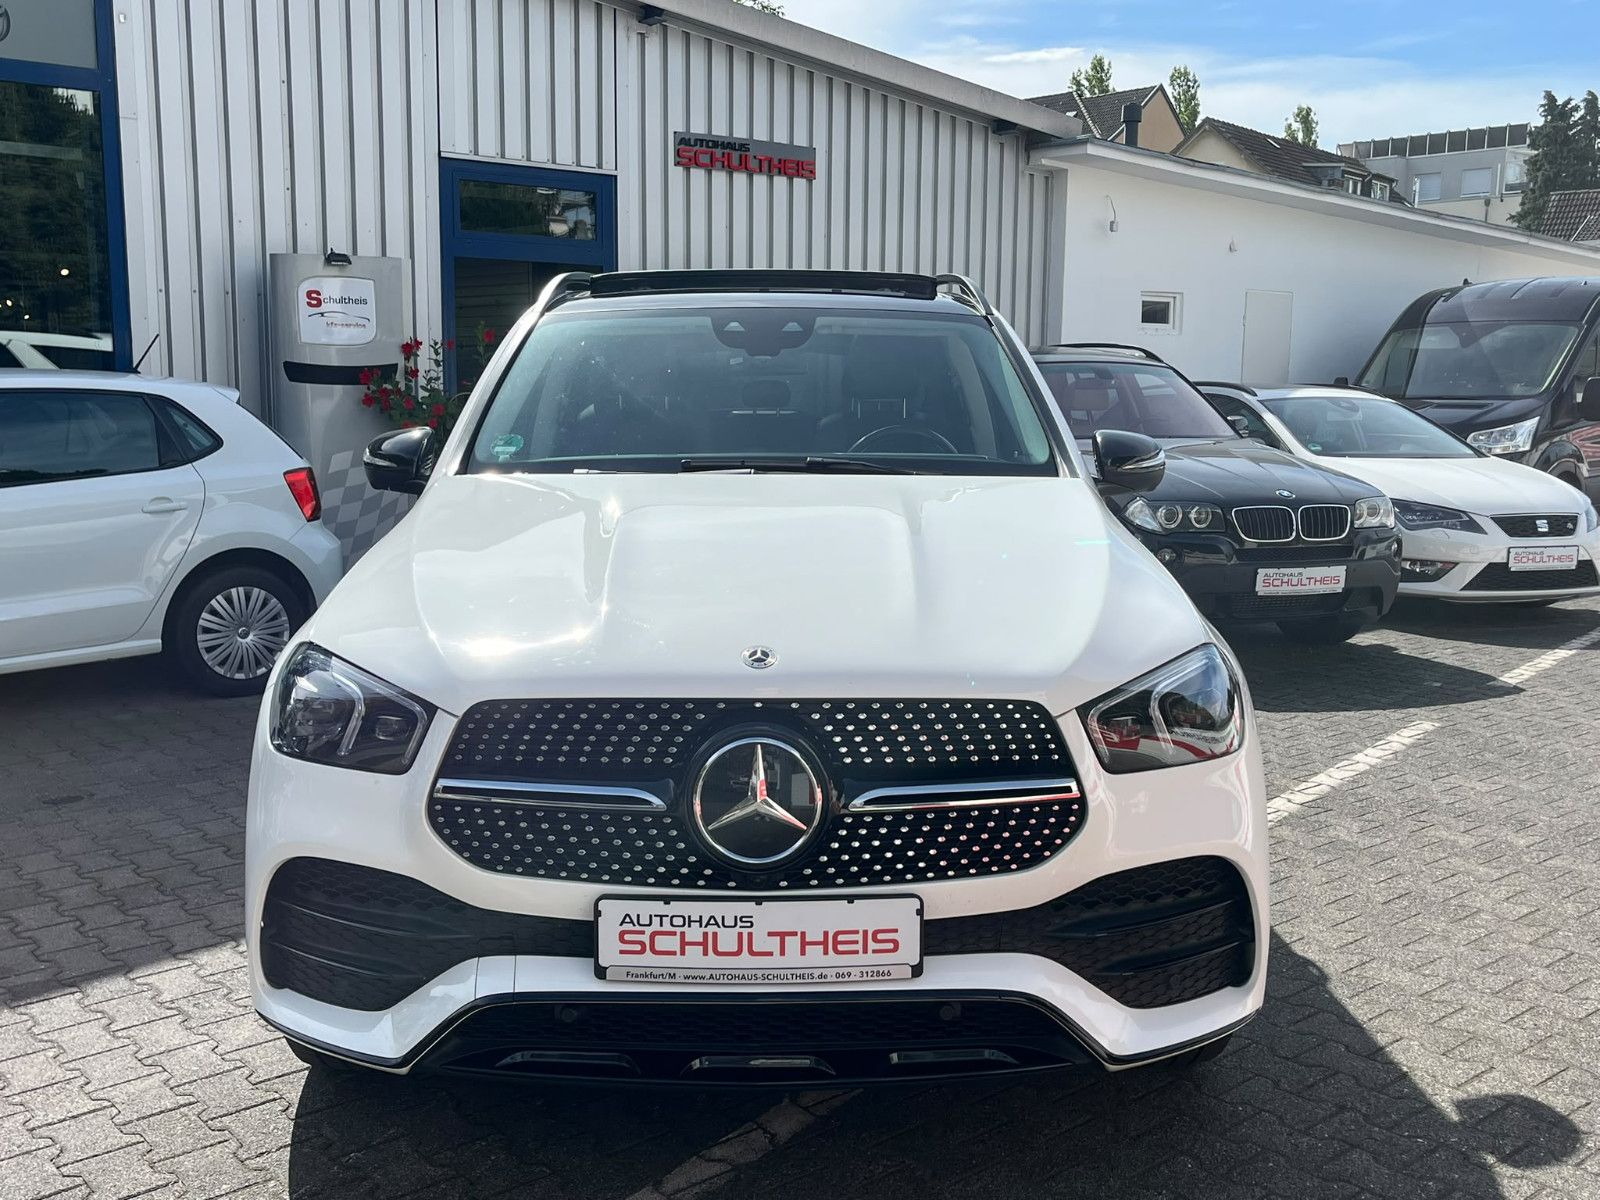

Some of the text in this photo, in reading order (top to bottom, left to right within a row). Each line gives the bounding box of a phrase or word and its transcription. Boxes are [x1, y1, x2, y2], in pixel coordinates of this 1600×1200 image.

[677, 137, 750, 152] AUTOHAUS
[676, 147, 816, 179] SCHULTHEIS
[305, 289, 368, 309] Schultheis
[1512, 554, 1574, 564] SCHULTHEIS
[1262, 575, 1341, 588] SCHULTHEIS
[619, 913, 754, 929] AUTOHAUS
[618, 928, 899, 957] SCHULTHEIS
[626, 969, 892, 982] Frankfurt/M www.AUTOHAUS-SCHULTHEIS.de 069 312866
